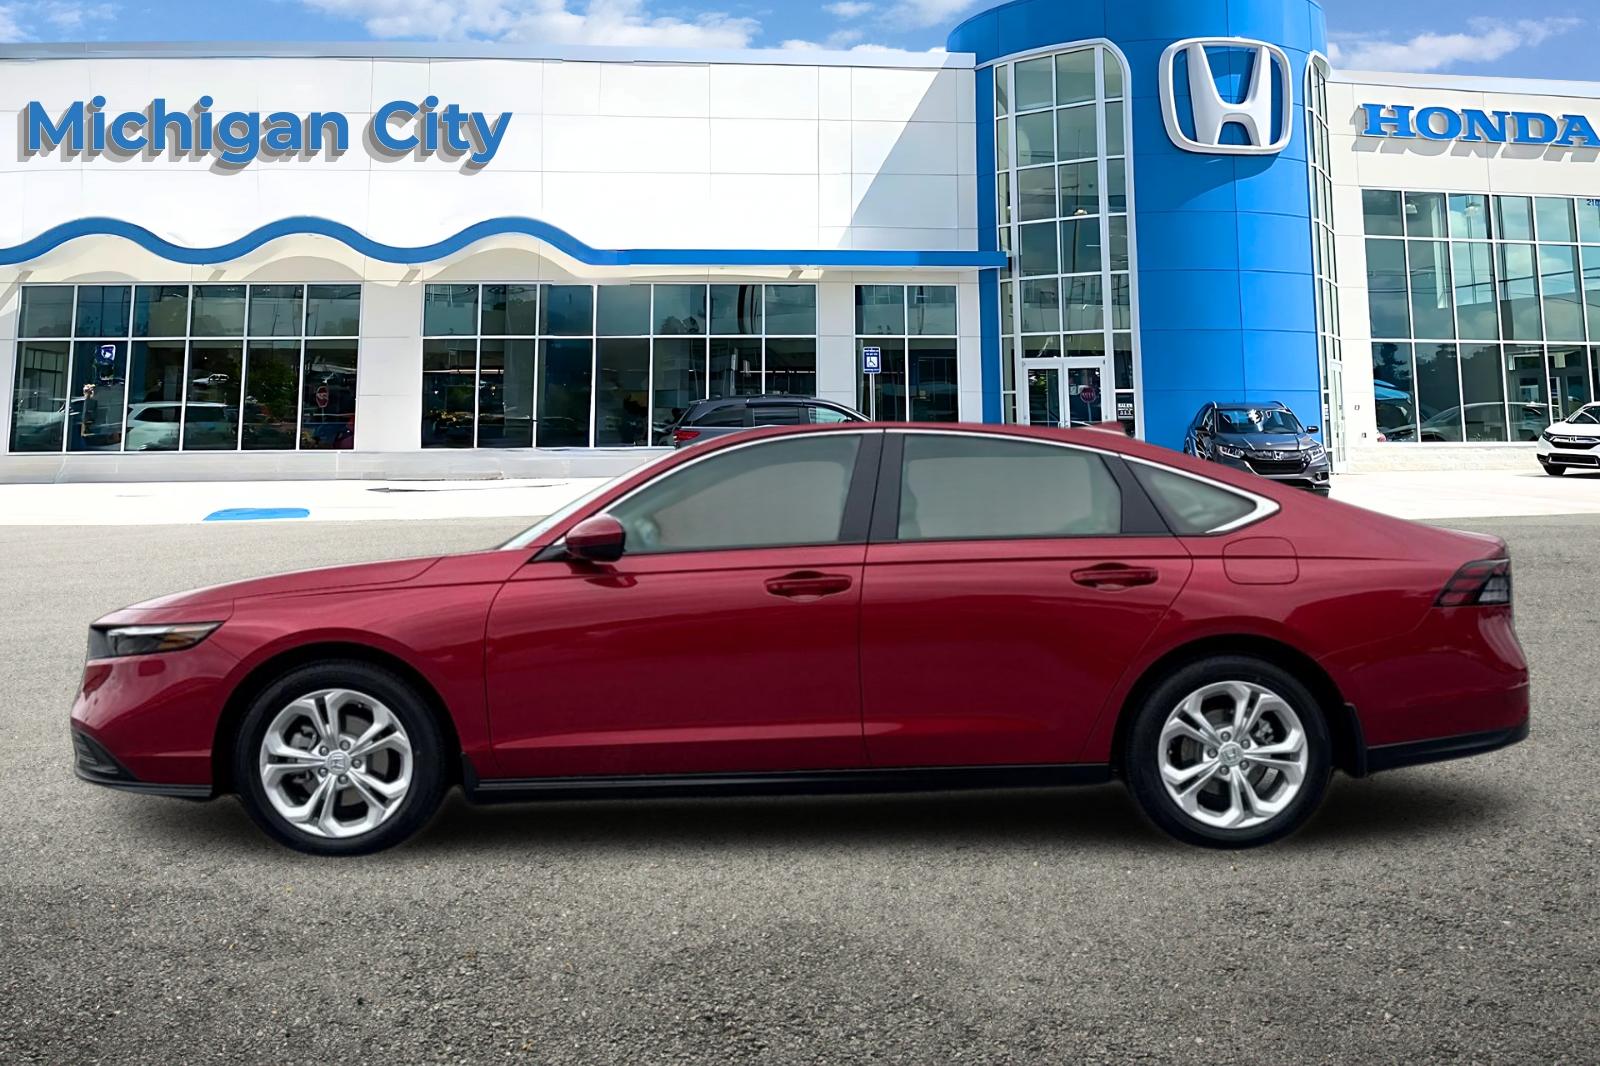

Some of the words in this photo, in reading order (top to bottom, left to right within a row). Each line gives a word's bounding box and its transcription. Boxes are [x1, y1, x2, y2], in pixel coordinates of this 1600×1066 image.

[28, 95, 350, 164] Michigan
[373, 95, 513, 164] City
[1361, 103, 1600, 147] HONDA
